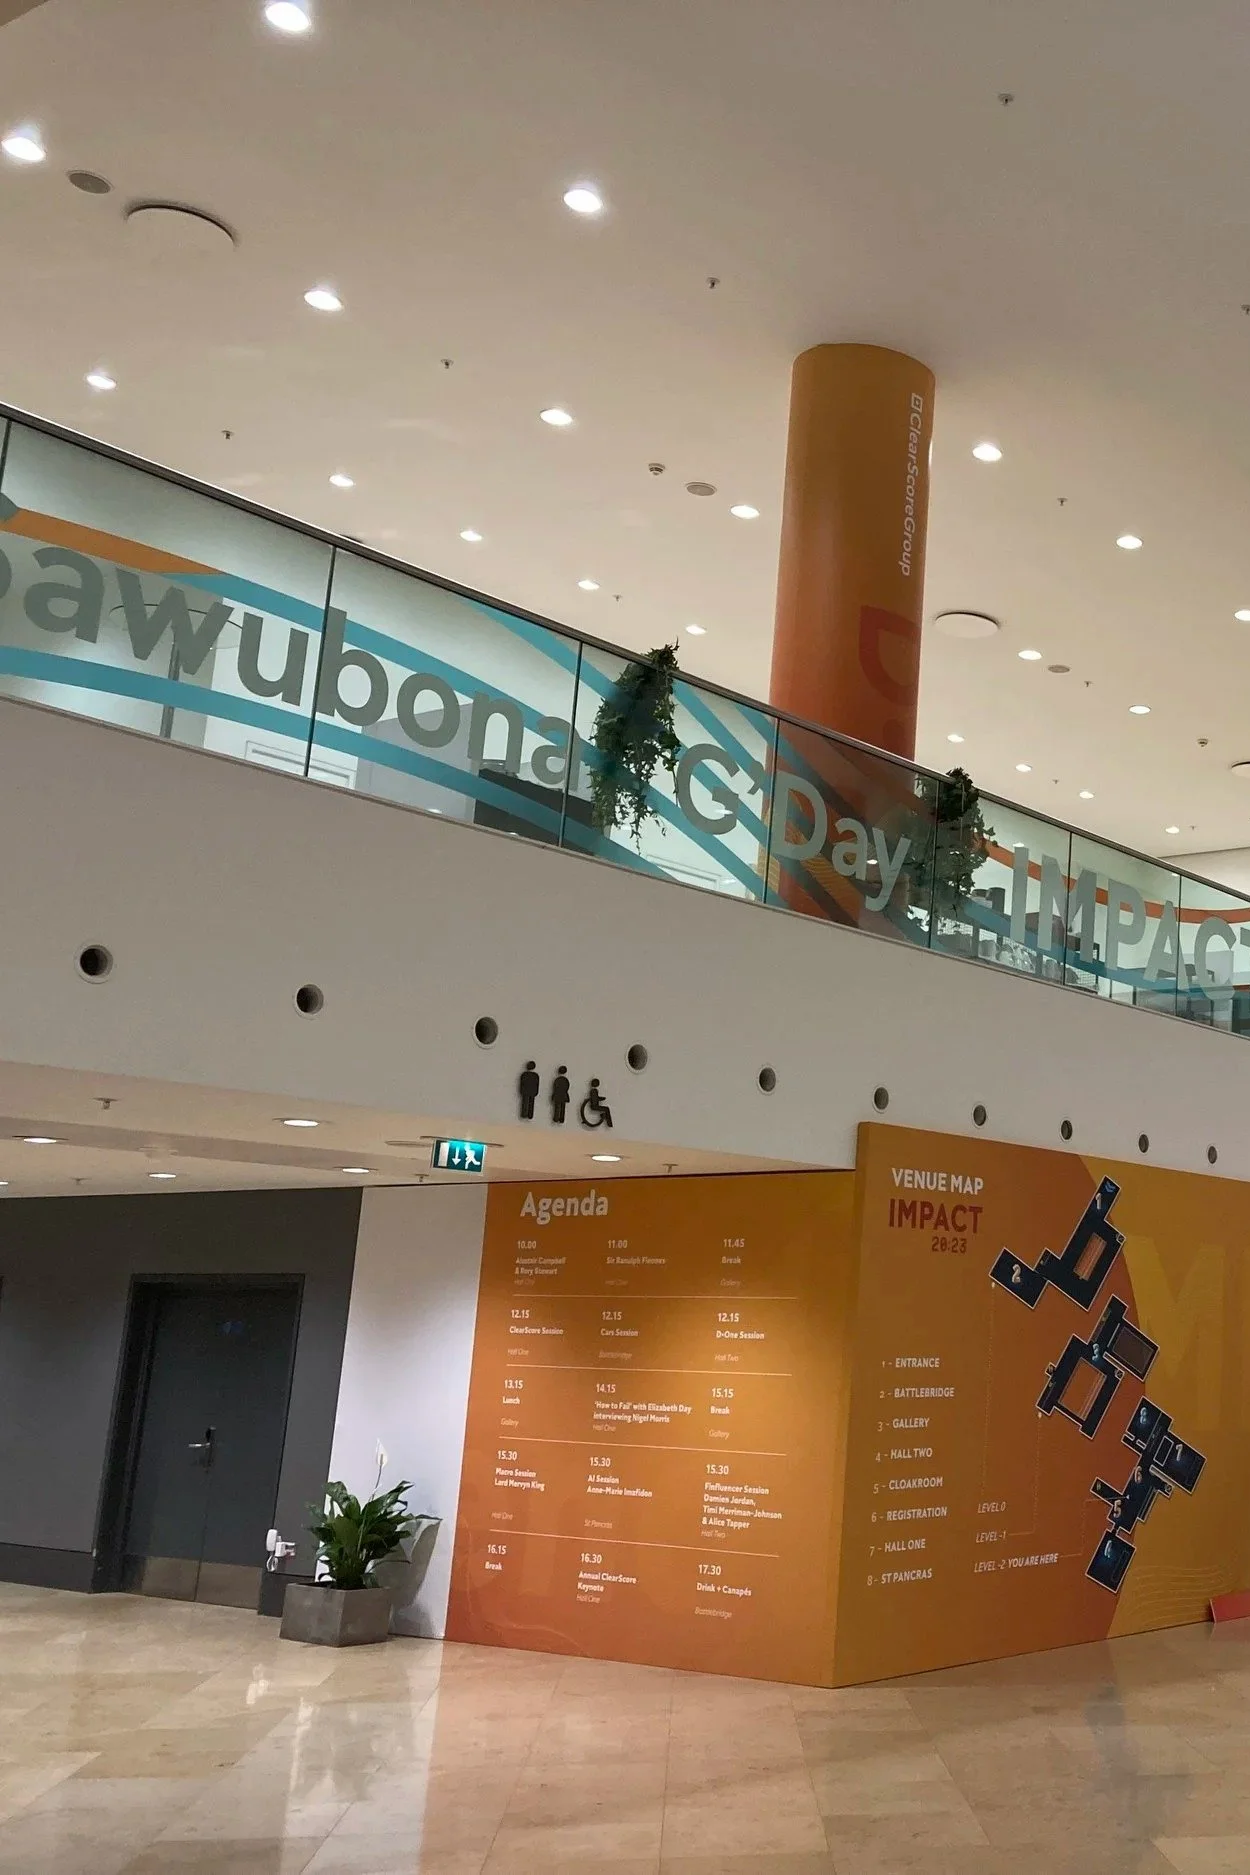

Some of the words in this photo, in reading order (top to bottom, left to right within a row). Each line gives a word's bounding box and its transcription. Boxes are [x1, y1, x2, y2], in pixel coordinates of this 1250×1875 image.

[897, 414, 922, 577] ClearScoreGroup
[0, 491, 583, 791] awubona
[892, 1168, 948, 1192] VENUE
[950, 1174, 984, 1196] MAP
[520, 1189, 609, 1225] Agenda
[1095, 1192, 1102, 1210] 1
[889, 1198, 983, 1234] IMPACT
[1011, 1264, 1022, 1284] 2
[511, 1309, 530, 1319] 12.15
[602, 1311, 622, 1321] 12.15
[718, 1313, 739, 1322] 12.15
[510, 1326, 540, 1334] ClearScore
[542, 1327, 564, 1335] Session
[600, 1328, 614, 1336] Cars
[616, 1329, 638, 1337] Session
[740, 1331, 764, 1340] Session
[1092, 1343, 1100, 1362] 3
[895, 1357, 940, 1368] ENTRANCE
[504, 1379, 523, 1390] 13.15
[596, 1383, 616, 1394] 14.15
[712, 1388, 734, 1398] 15.15
[894, 1387, 955, 1398] BATTLEBRIDGE
[502, 1396, 520, 1404] Lunch
[648, 1403, 678, 1412] Elizabeth
[679, 1405, 692, 1415] Day
[710, 1406, 730, 1414] Break
[594, 1412, 631, 1423] interviewing
[633, 1414, 648, 1424] Nigel
[877, 1421, 883, 1432] 3
[892, 1417, 930, 1430] GALLERY
[498, 1450, 518, 1461] 15.30
[875, 1452, 881, 1463] 4
[890, 1449, 912, 1460] HALL
[912, 1447, 933, 1458] TWO
[589, 1456, 610, 1467] 15.30
[514, 1468, 536, 1478] Session
[706, 1464, 729, 1475] 15.30
[495, 1478, 508, 1488] Lord
[532, 1480, 544, 1492] King
[596, 1474, 619, 1484] Session
[873, 1483, 879, 1494] 5
[888, 1476, 944, 1490] CLOAKROOM
[587, 1486, 622, 1496] Anne-Marie
[705, 1482, 743, 1493] Finfluencer
[744, 1485, 770, 1495] Session
[719, 1507, 782, 1520] Merriman-Johnson
[872, 1511, 877, 1522] 6
[886, 1506, 948, 1522] REGISTRATION
[978, 1502, 1000, 1514] LEVEL
[1113, 1499, 1122, 1518] 5
[708, 1517, 725, 1527] Alice
[726, 1519, 750, 1530] Tapper
[976, 1532, 998, 1544] LEVEL
[999, 1530, 1007, 1541] -1
[488, 1544, 506, 1555] 16.15
[869, 1546, 875, 1559] 7
[884, 1540, 906, 1552] HALL
[908, 1538, 926, 1550] ONE
[581, 1552, 602, 1564] 16.30
[974, 1562, 996, 1573] LEVEL
[998, 1560, 1006, 1571] -2
[1008, 1558, 1023, 1568] YOU
[1024, 1556, 1038, 1567] ARE
[1040, 1553, 1059, 1565] HERE
[486, 1562, 502, 1570] Break
[698, 1564, 721, 1576] 17.30
[579, 1571, 600, 1580] Annual
[602, 1572, 636, 1584] ClearScore
[867, 1575, 873, 1586] 8
[881, 1573, 892, 1584] ST
[892, 1568, 932, 1583] PANCRAS
[578, 1582, 604, 1593] Keynote
[697, 1582, 716, 1594] Drink
